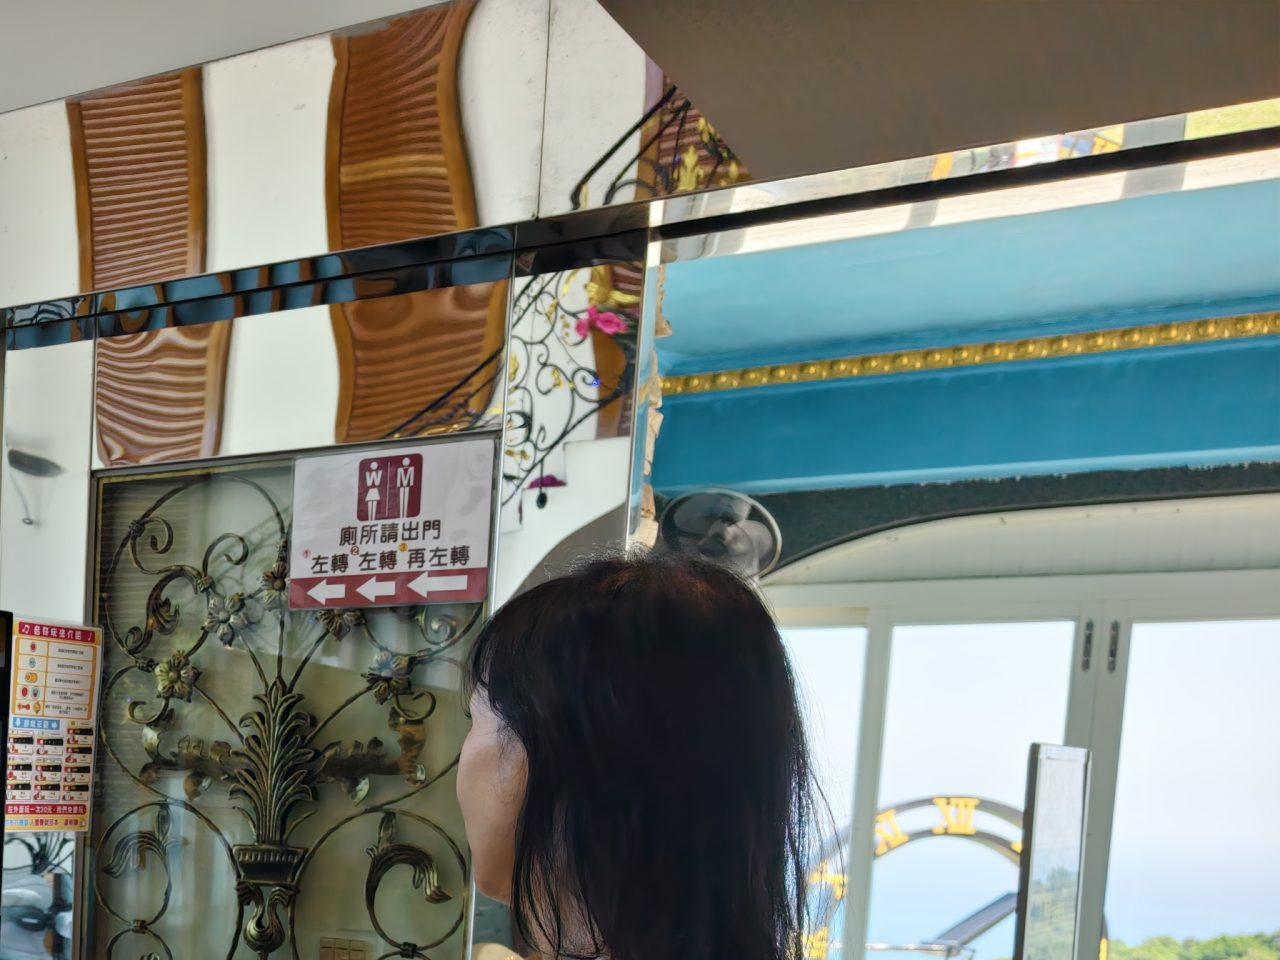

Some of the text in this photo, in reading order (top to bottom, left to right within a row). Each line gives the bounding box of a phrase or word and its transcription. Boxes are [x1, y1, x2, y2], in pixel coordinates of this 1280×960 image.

[339, 519, 441, 547] 廁所請出門
[311, 553, 349, 574] 左轉
[358, 550, 397, 571] 左轉
[407, 545, 470, 568] 再左轉
